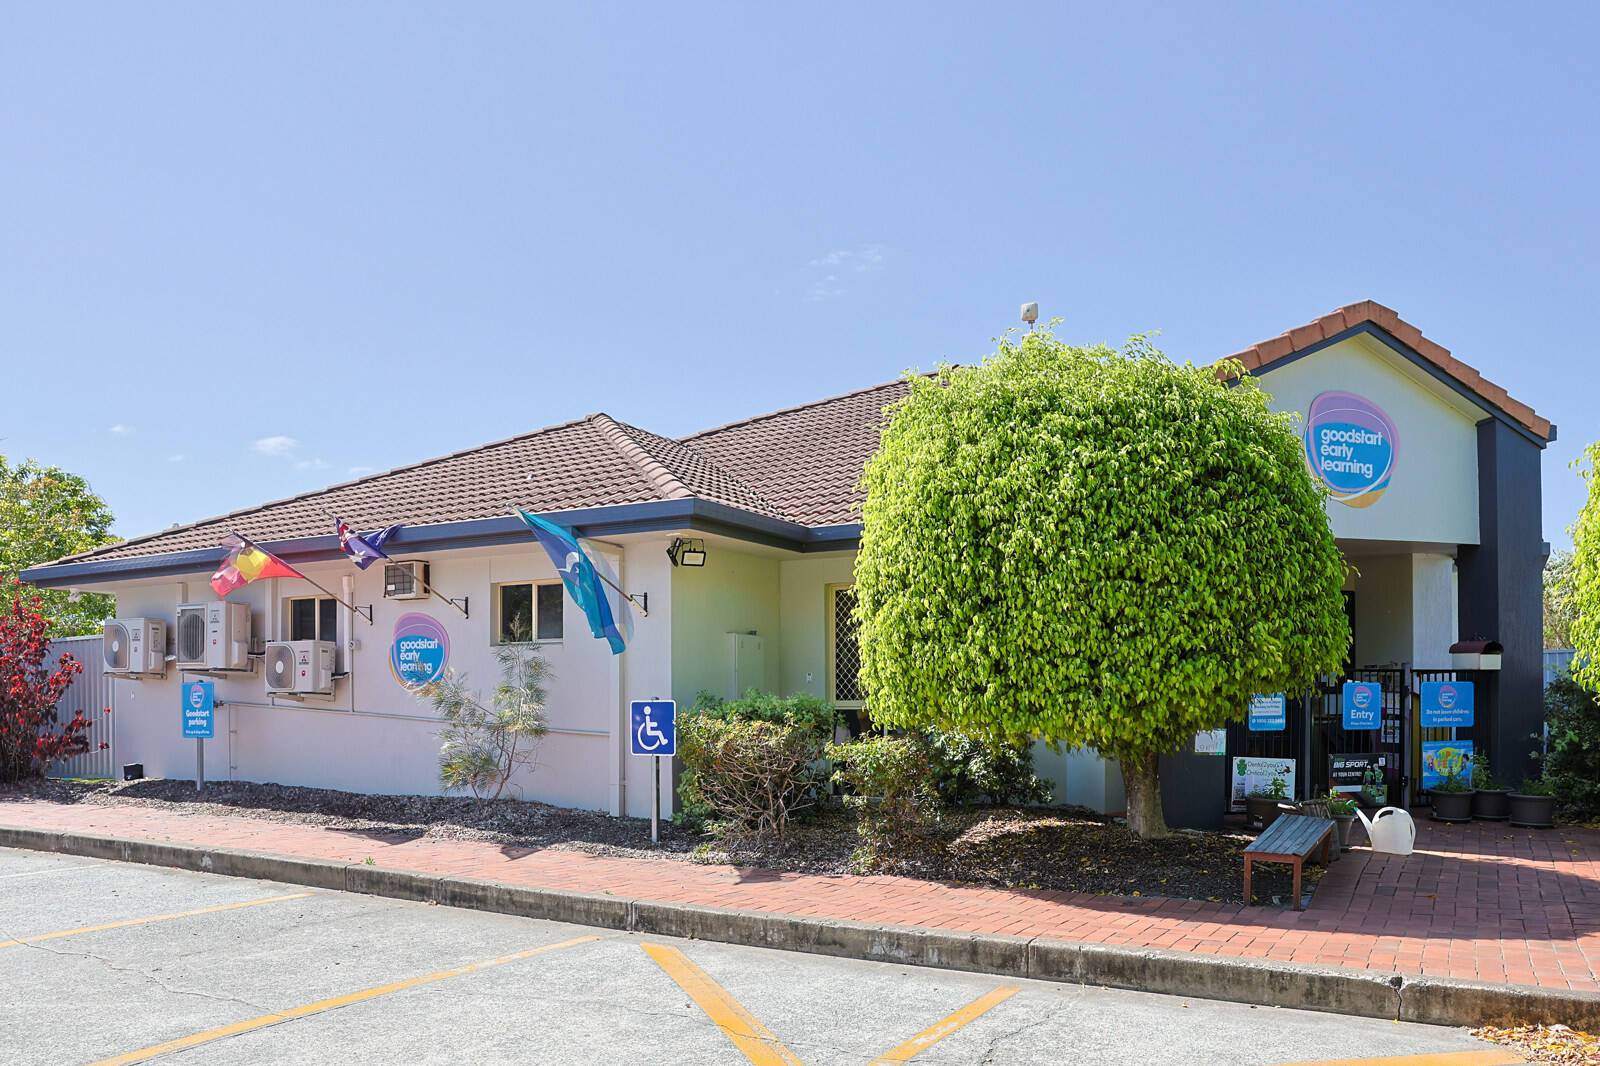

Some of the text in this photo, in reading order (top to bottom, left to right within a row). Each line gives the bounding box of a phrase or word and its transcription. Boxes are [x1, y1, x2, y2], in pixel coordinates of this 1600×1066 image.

[1321, 428, 1383, 446] goodstart
[1320, 443, 1354, 461] early
[1321, 456, 1373, 479] learning
[400, 638, 439, 652] goodstart
[400, 650, 420, 662] early
[185, 709, 210, 717] Goodstart
[1350, 709, 1374, 721] Entry
[188, 717, 207, 727] parking
[1333, 761, 1345, 769] BIG
